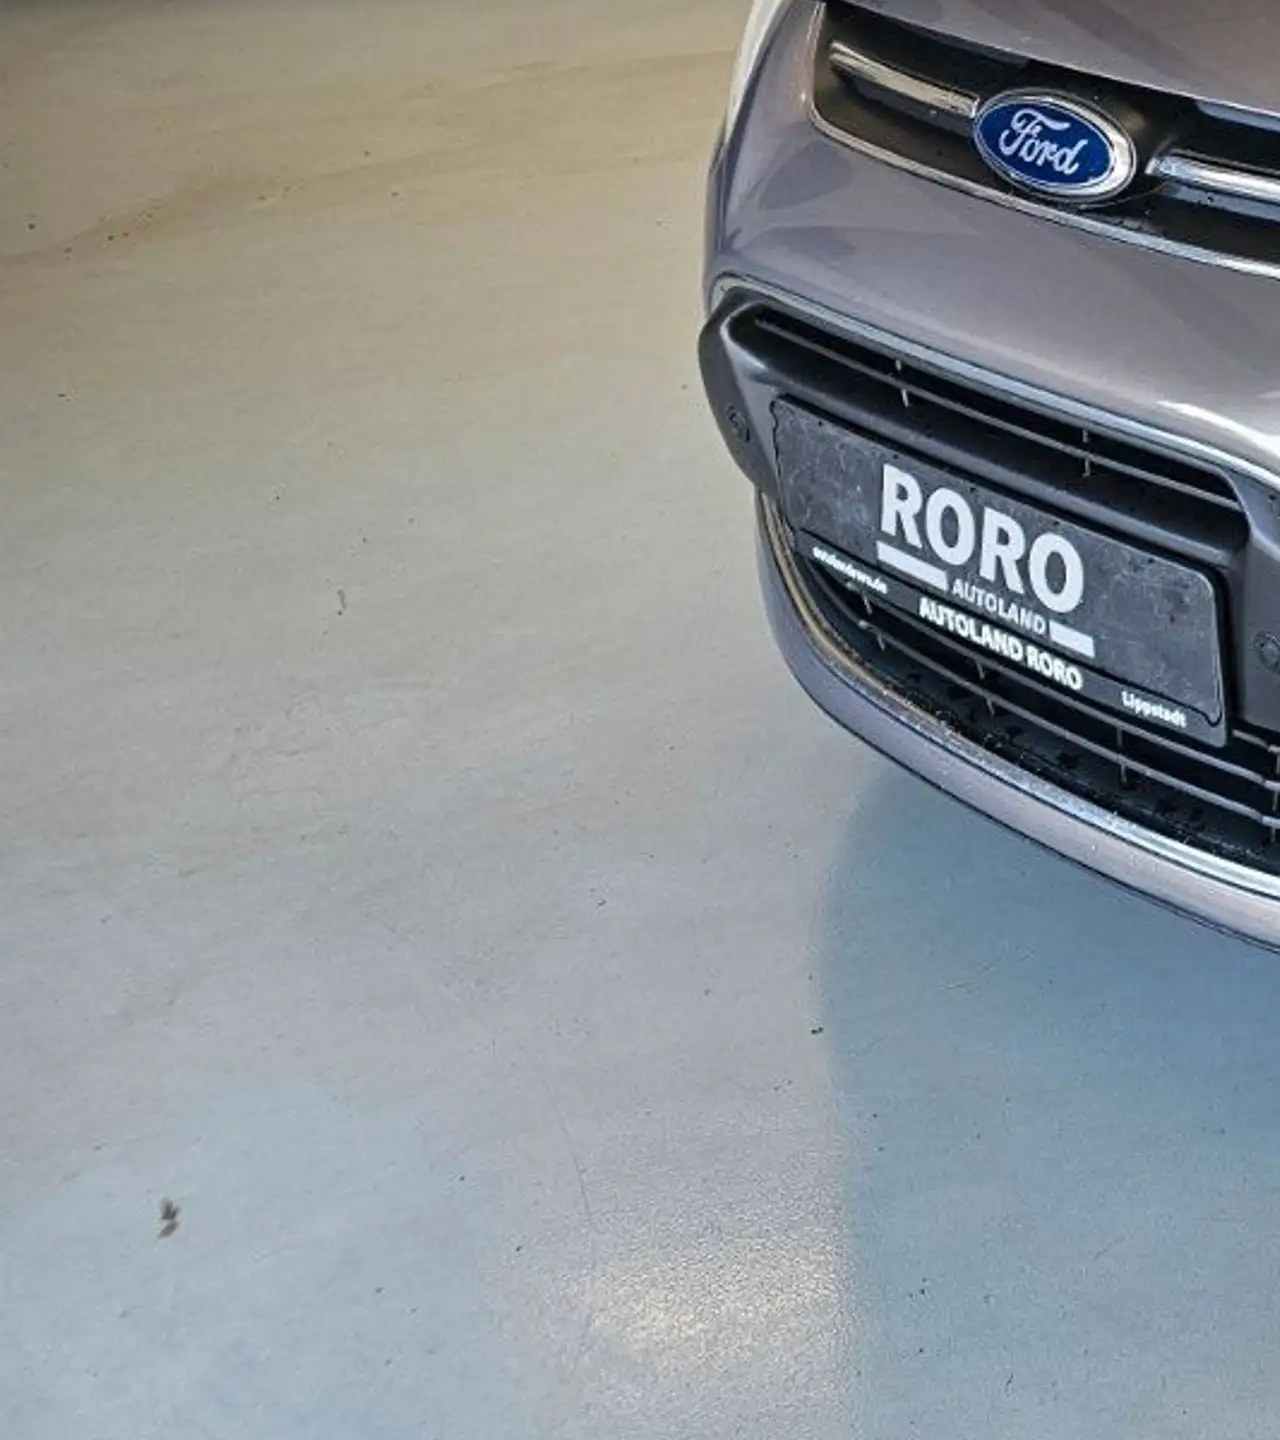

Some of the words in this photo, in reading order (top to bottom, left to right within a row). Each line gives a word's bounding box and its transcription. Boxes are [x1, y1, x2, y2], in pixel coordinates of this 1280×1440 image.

[1000, 109, 1090, 175] Ford
[880, 463, 1085, 614] RORO
[919, 596, 1024, 661] AUTOLAND
[1024, 643, 1084, 691] RORO
[952, 577, 1046, 635] AUTOLAND
